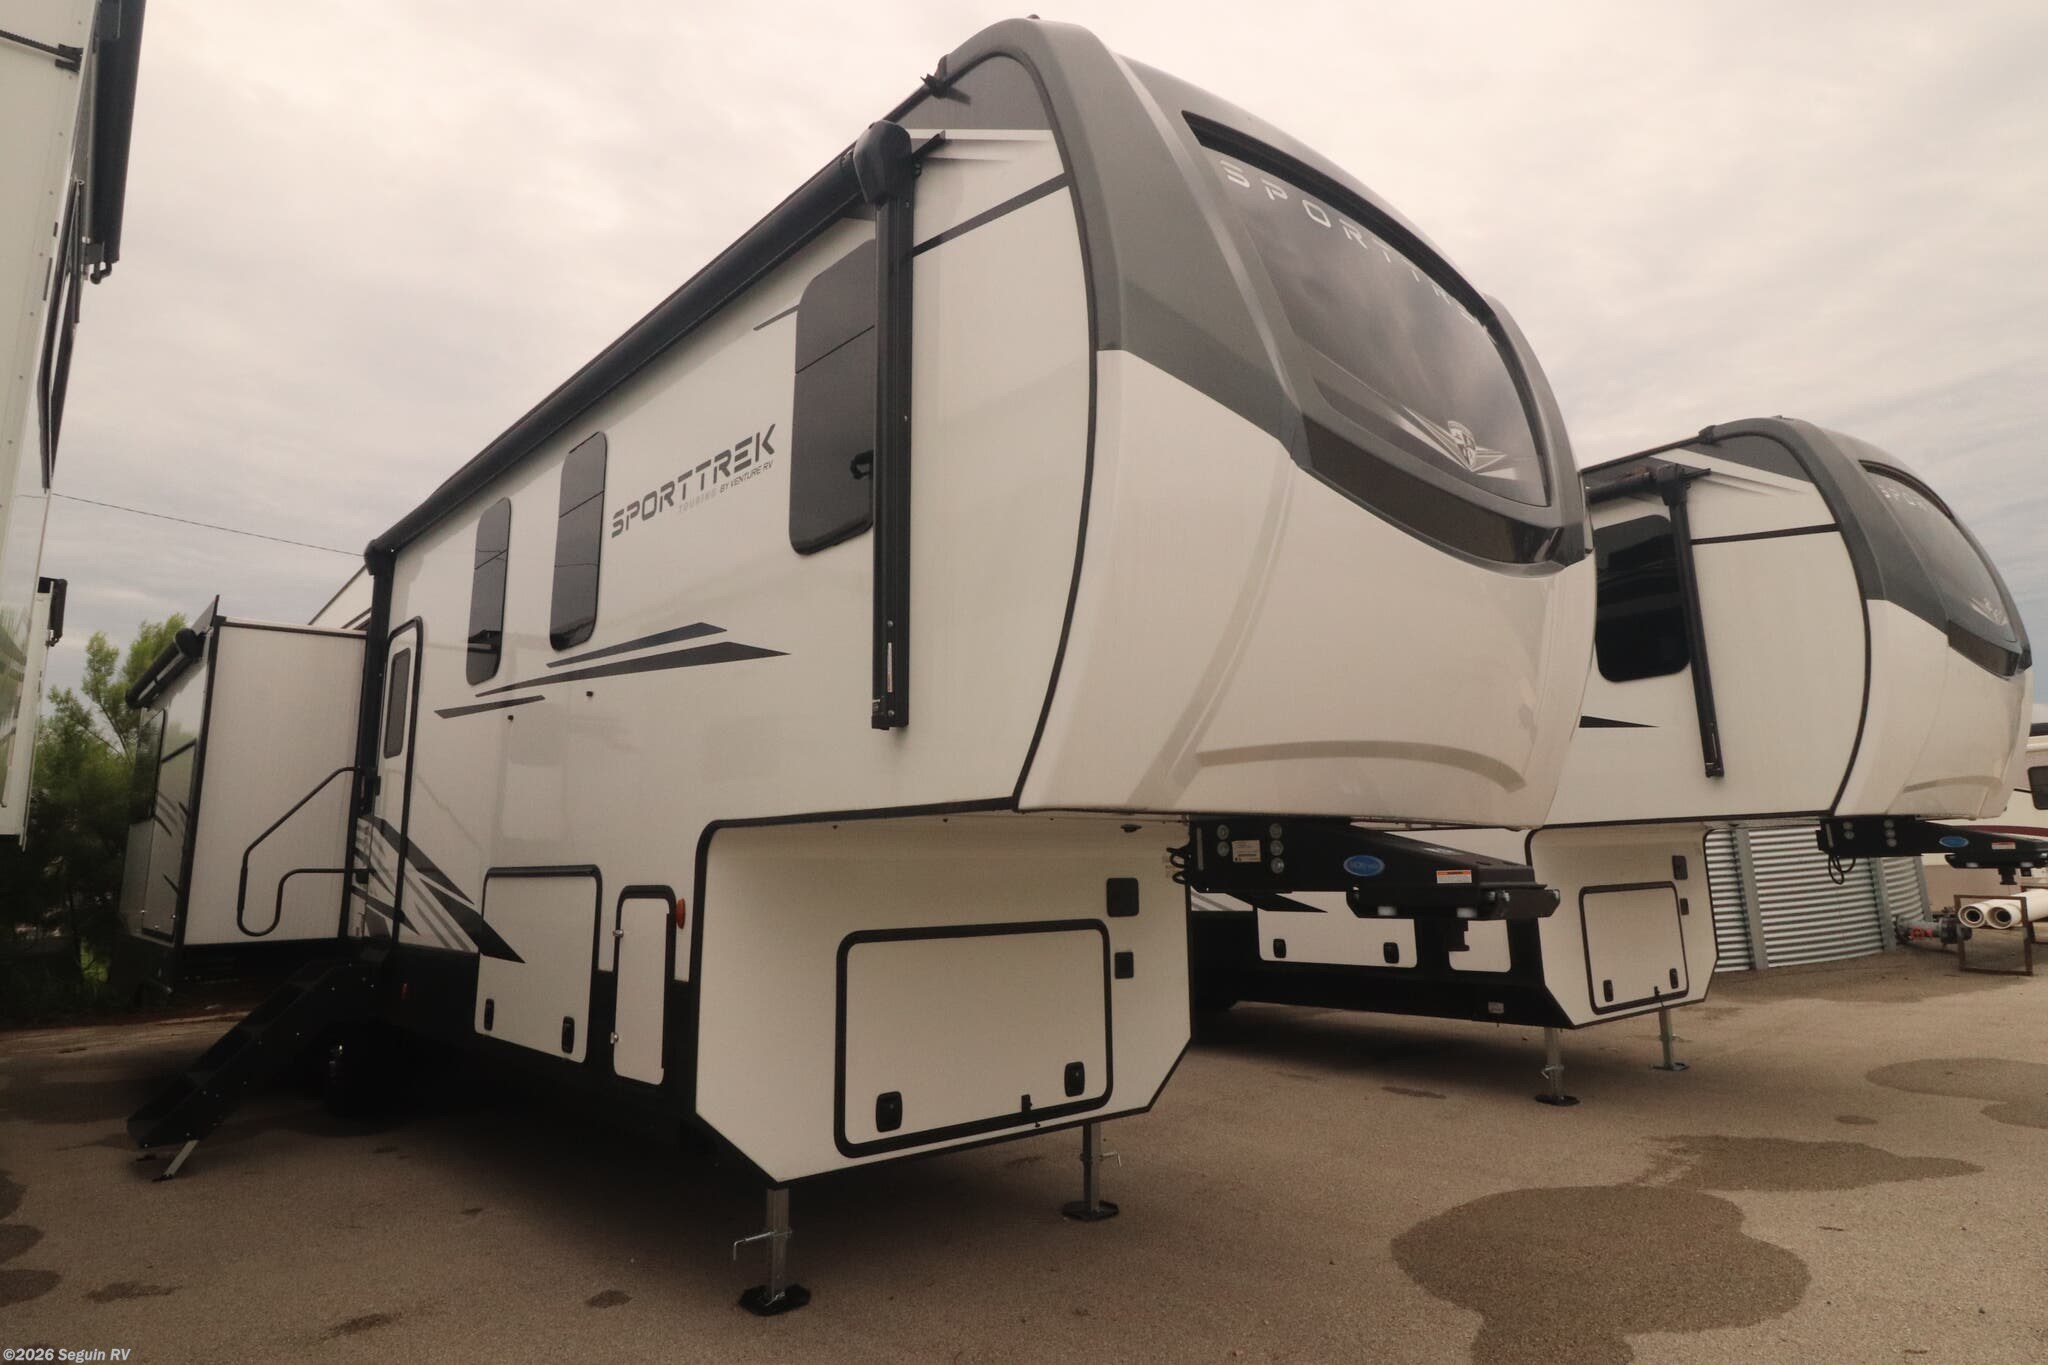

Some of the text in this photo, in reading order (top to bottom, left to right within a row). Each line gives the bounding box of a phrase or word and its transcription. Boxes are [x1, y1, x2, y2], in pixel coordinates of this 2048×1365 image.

[611, 423, 776, 539] SPORTTREK
[719, 482, 730, 494] BY
[729, 466, 762, 488] VENTURE
[762, 460, 774, 471] RV
